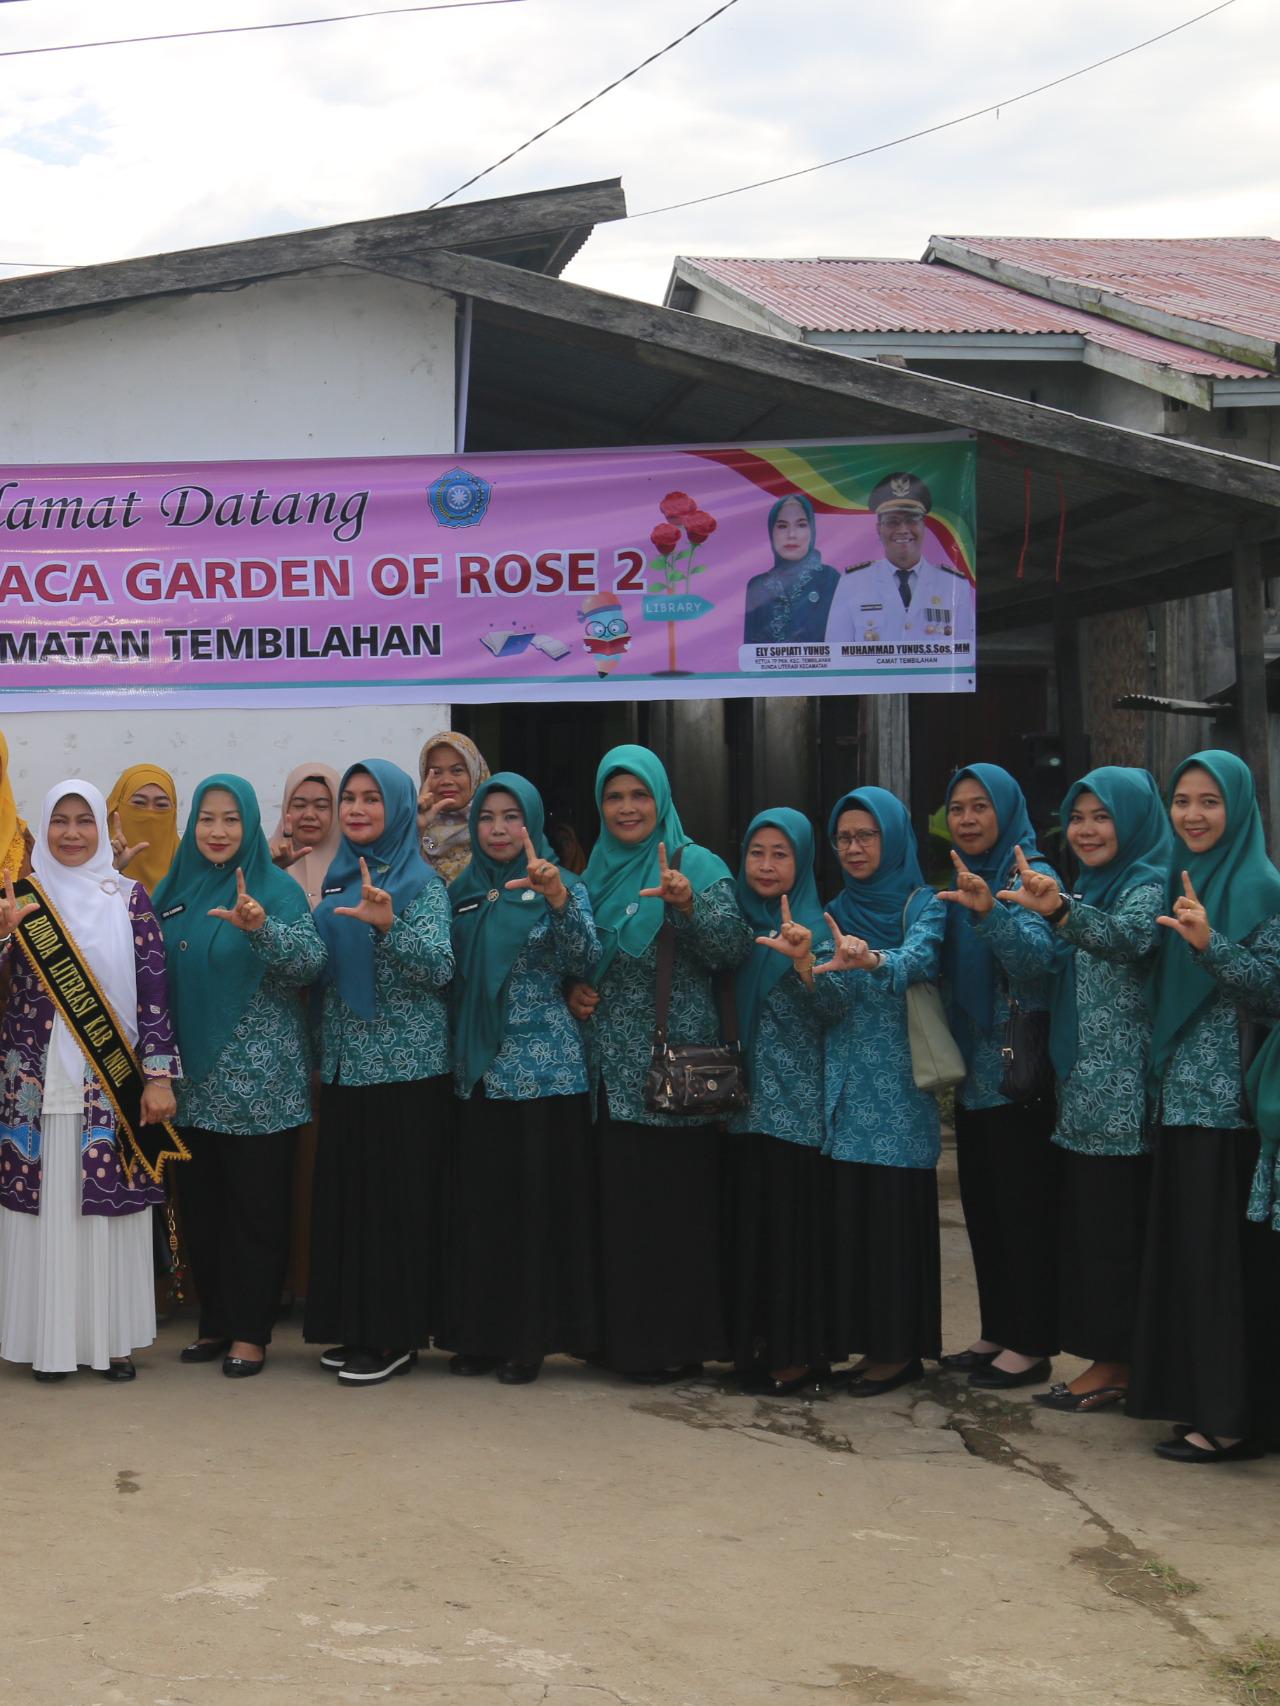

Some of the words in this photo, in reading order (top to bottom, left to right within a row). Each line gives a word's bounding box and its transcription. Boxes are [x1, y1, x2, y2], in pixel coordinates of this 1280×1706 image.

[160, 484, 371, 543] Datang
[124, 557, 352, 603] GARDEN
[370, 555, 440, 600] OF
[458, 551, 598, 595] ROSE
[615, 550, 647, 593] 2
[645, 601, 703, 615] LIBRARY
[164, 623, 443, 664] TEMBILAHAN
[755, 646, 769, 657] ELY
[770, 646, 802, 657] SUPIATI
[803, 645, 831, 656] YUNUS
[841, 645, 895, 656] MUHAMMAD
[954, 642, 971, 653] MM
[24, 914, 64, 961] BUNDA
[48, 955, 99, 1019] LITERASI
[83, 1012, 113, 1053] KAB.
[102, 1047, 133, 1089] INHIL
